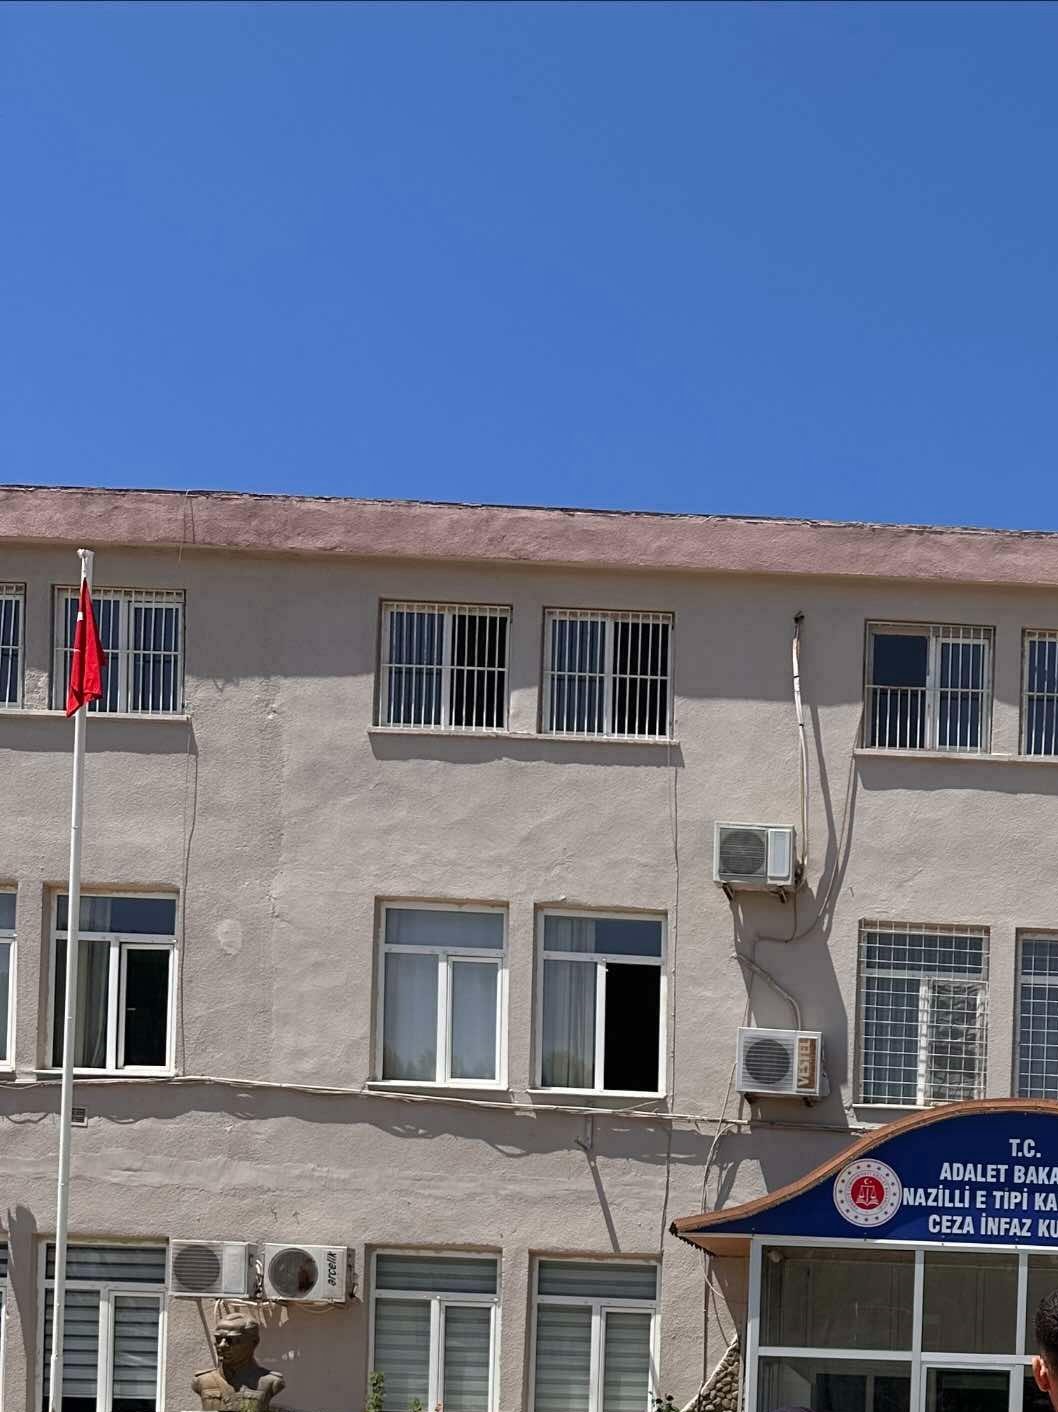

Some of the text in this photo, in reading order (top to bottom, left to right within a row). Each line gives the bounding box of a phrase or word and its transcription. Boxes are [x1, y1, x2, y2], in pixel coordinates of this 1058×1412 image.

[797, 1039, 811, 1087] VESTEL
[1009, 1138, 1042, 1158] T.C.
[939, 1162, 1009, 1183] ADALET
[902, 1185, 970, 1208] NAZİLLİ
[976, 1190, 987, 1208] E
[992, 1187, 1028, 1210] TİPİ
[928, 1214, 975, 1235] CEZA
[980, 1212, 1032, 1237] İNFAZ
